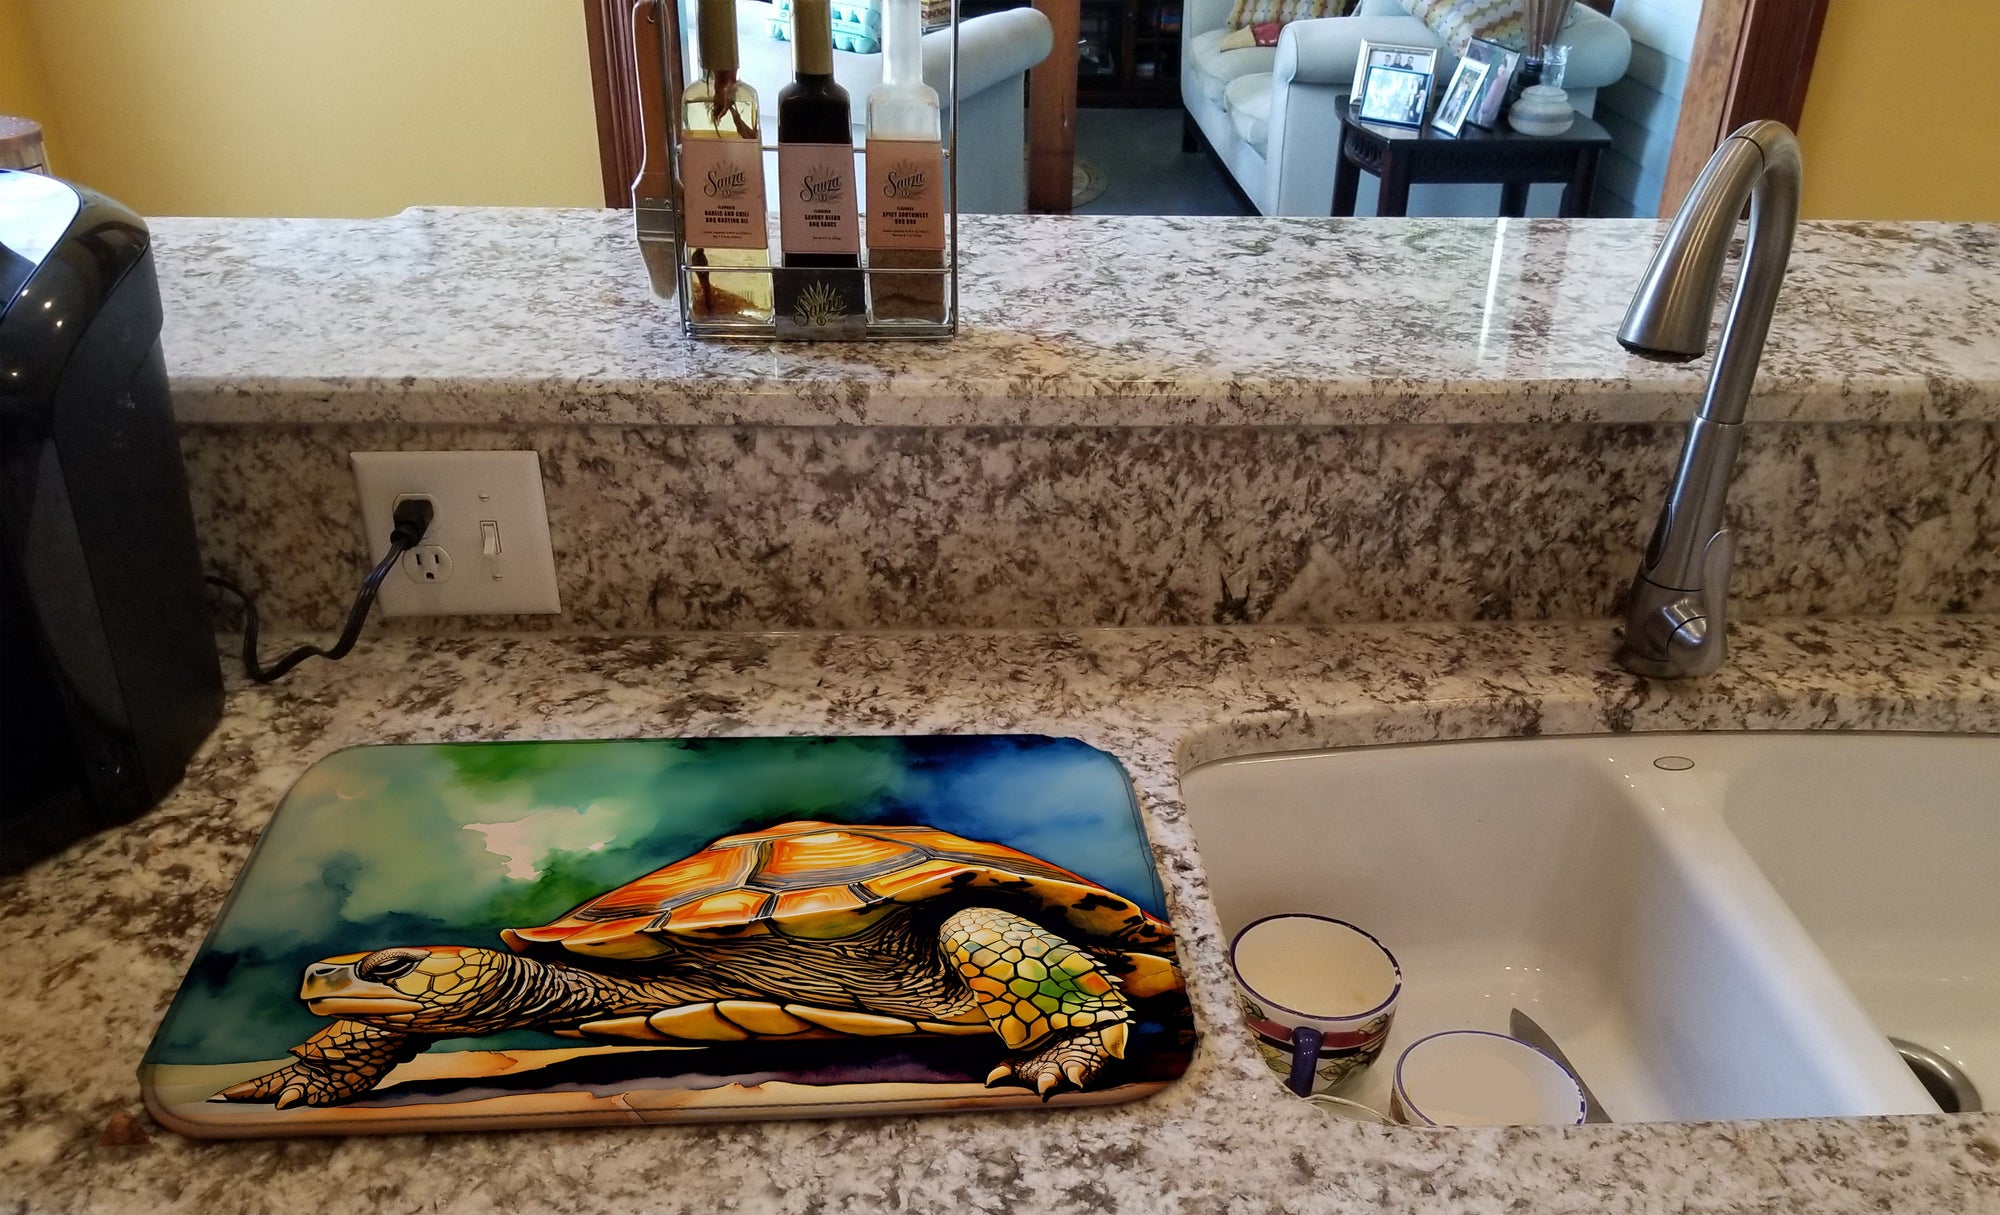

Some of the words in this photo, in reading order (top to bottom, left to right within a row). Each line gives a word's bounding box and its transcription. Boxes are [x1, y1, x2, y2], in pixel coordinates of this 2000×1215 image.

[704, 170, 746, 197] Sauza
[800, 175, 841, 202] Sauza
[884, 171, 925, 198] Sauza
